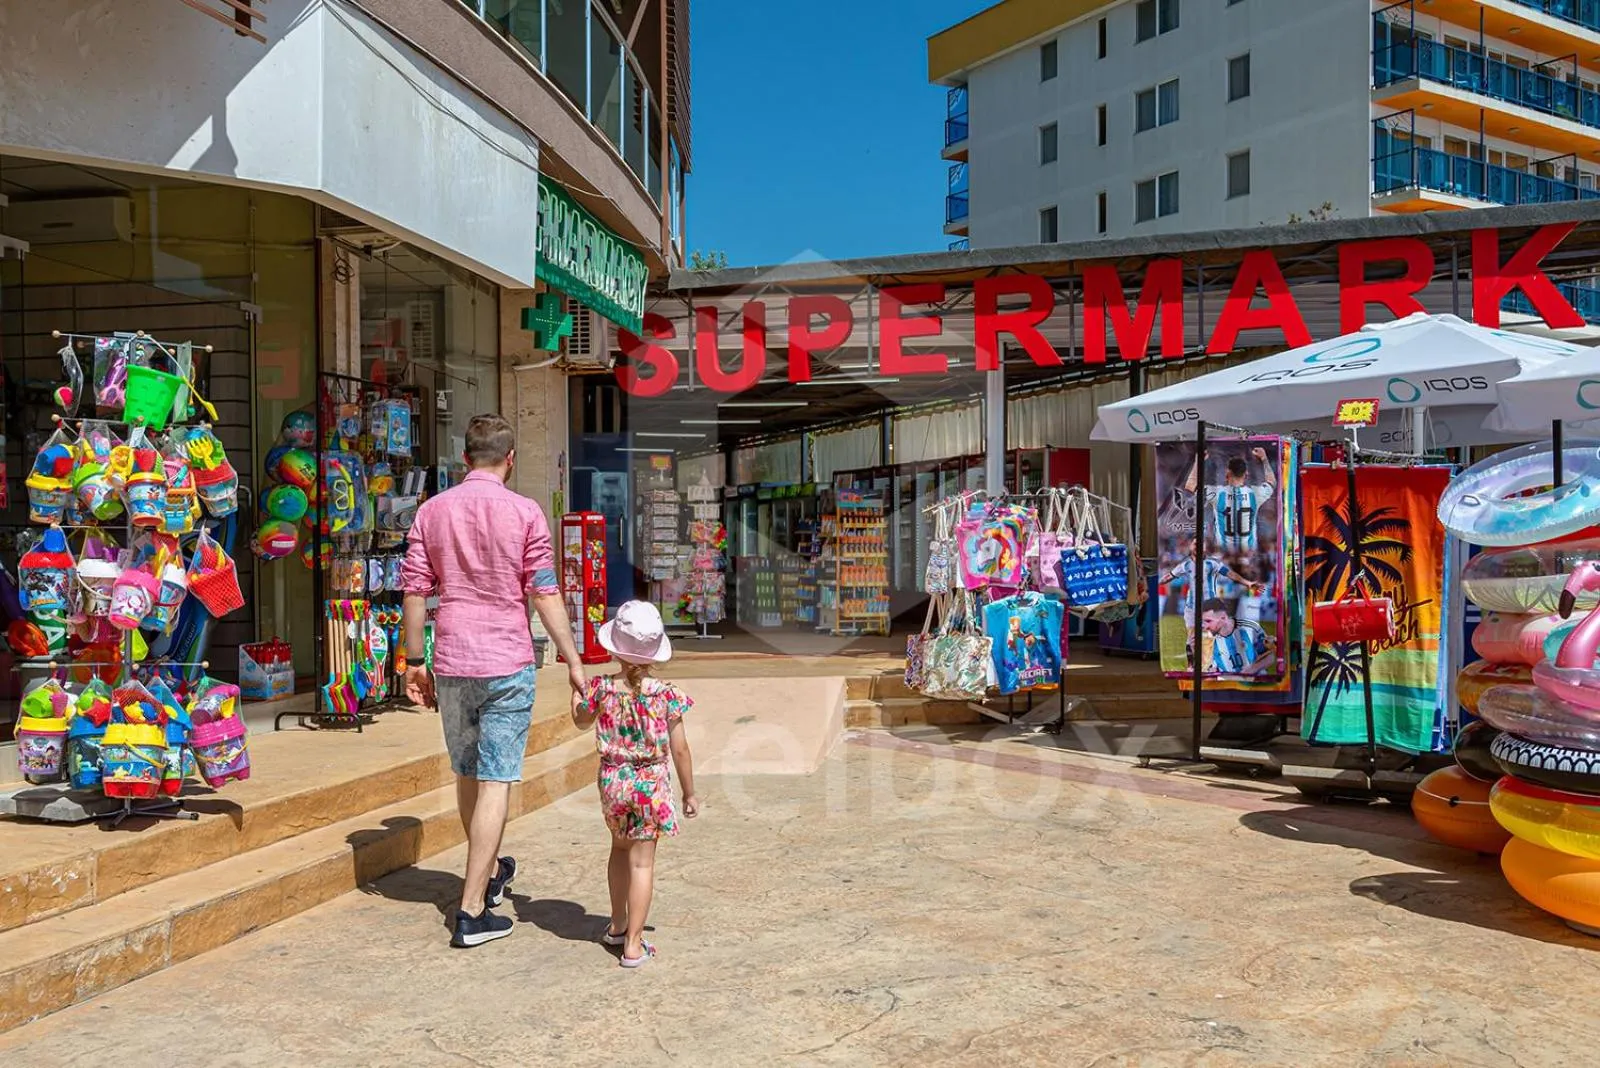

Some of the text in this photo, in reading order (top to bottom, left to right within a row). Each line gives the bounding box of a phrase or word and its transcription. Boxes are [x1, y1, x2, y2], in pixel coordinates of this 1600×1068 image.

[613, 221, 1586, 397] SUPERMARK
[1239, 358, 1378, 384] IQOS
[1423, 376, 1488, 393] IQOS
[1153, 407, 1200, 425] IQOS
[1222, 506, 1252, 537] 10
[1229, 653, 1243, 669] 10
